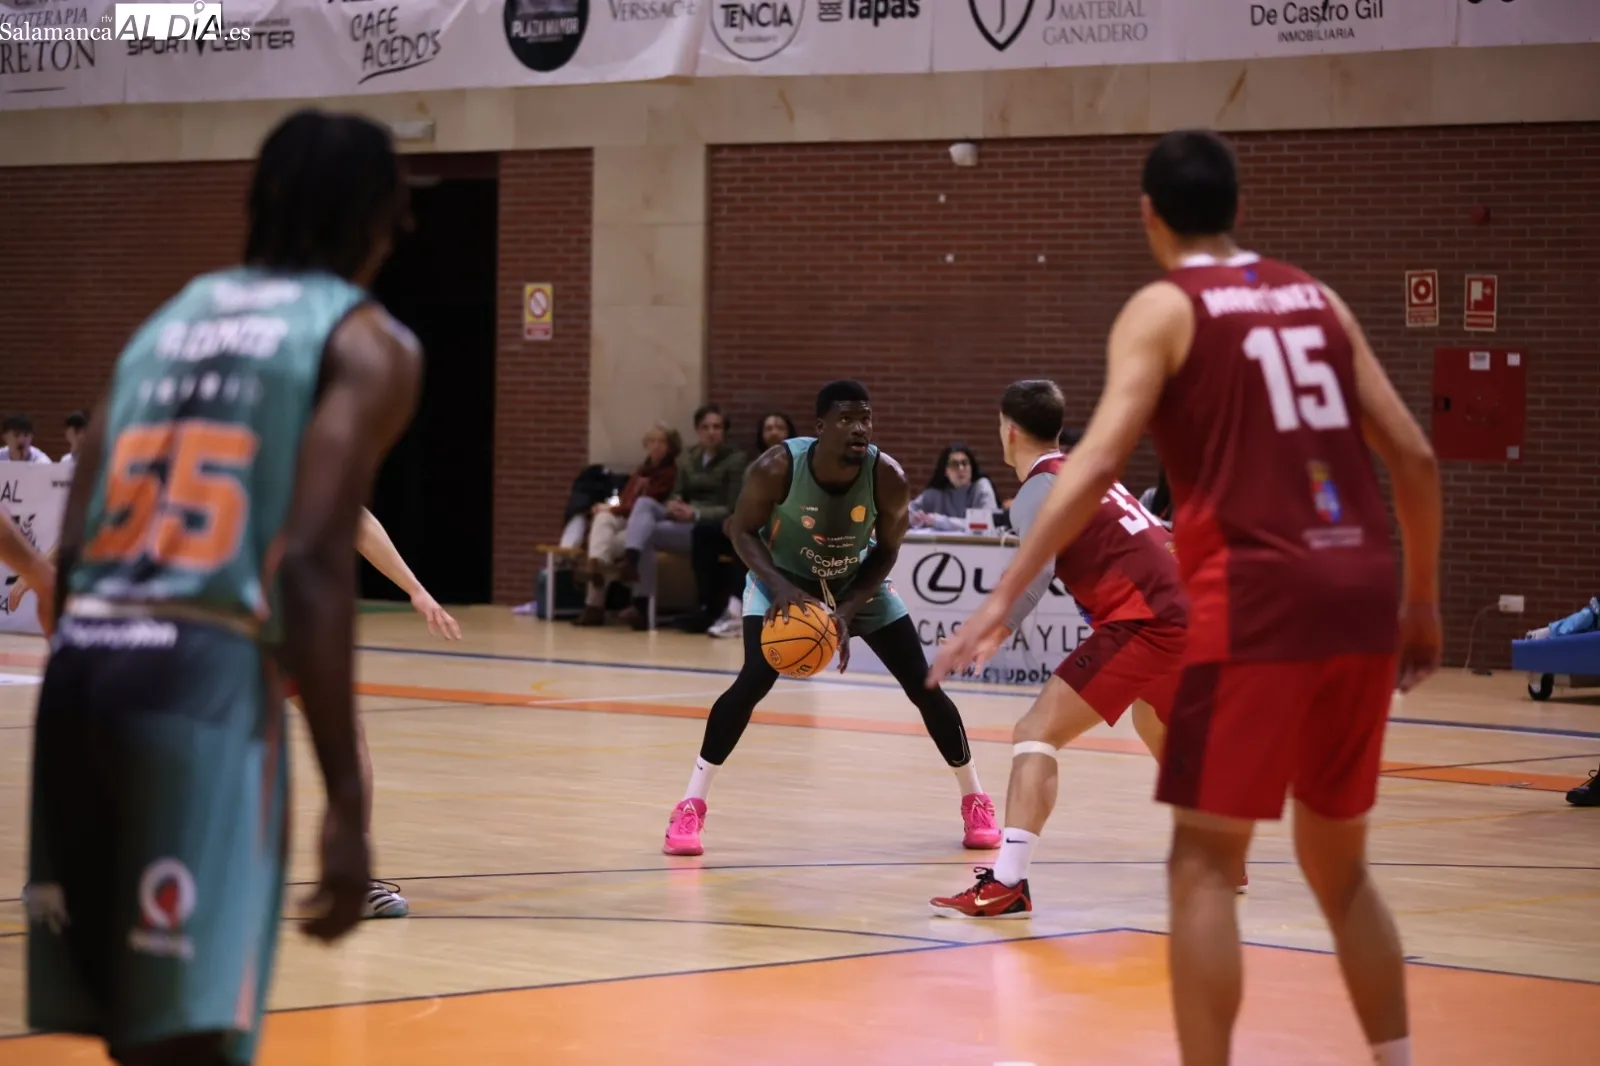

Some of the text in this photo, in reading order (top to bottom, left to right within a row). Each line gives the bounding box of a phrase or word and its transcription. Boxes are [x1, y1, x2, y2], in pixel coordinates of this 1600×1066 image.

[1060, 0, 1146, 20] MATERIAL
[1250, 0, 1383, 26] De Castro Gil
[352, 6, 399, 41] CAFE
[1042, 23, 1148, 46] GANADERO
[1278, 27, 1355, 43] INMOBILIARIA
[362, 29, 442, 70] ACEDOS
[1242, 326, 1349, 433] 15
[0, 480, 22, 503] AL
[84, 418, 261, 571] 55
[800, 547, 859, 568] recoleta
[811, 564, 849, 578] salud
[1037, 625, 1053, 652] Y
